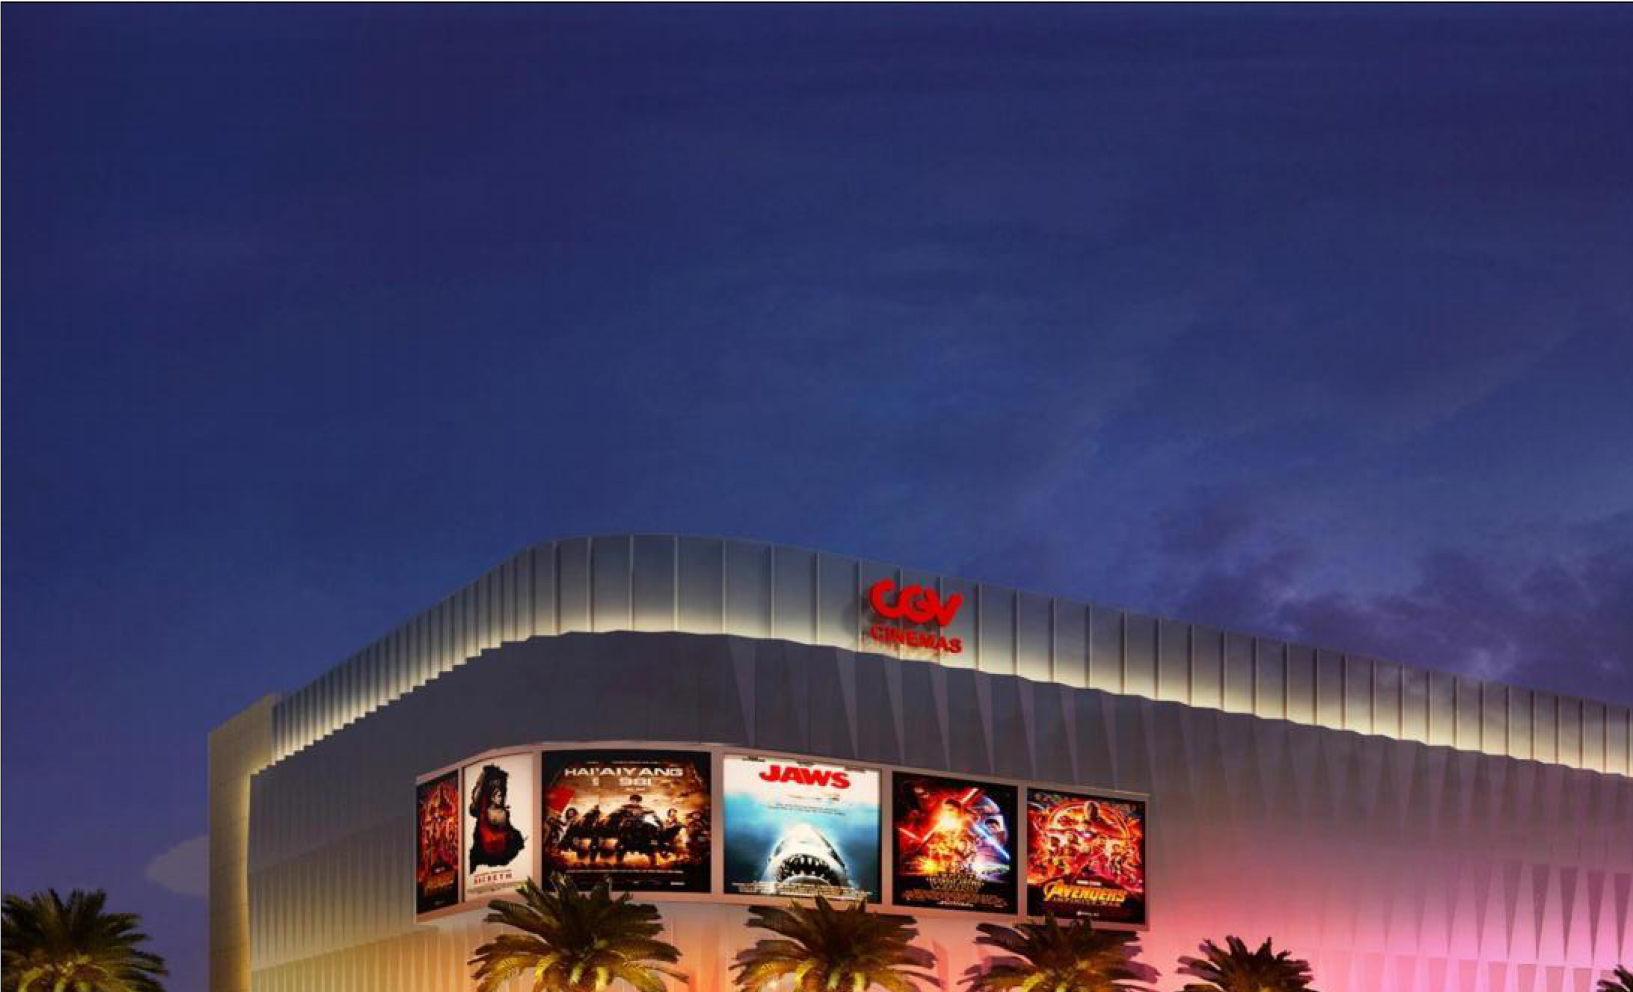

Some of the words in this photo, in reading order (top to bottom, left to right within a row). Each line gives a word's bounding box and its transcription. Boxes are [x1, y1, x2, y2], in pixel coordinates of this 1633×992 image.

[869, 579, 963, 627] CGV
[869, 624, 963, 654] CINEMAS
[759, 764, 851, 790] JAWS
[1043, 879, 1128, 903] AVENGERS
